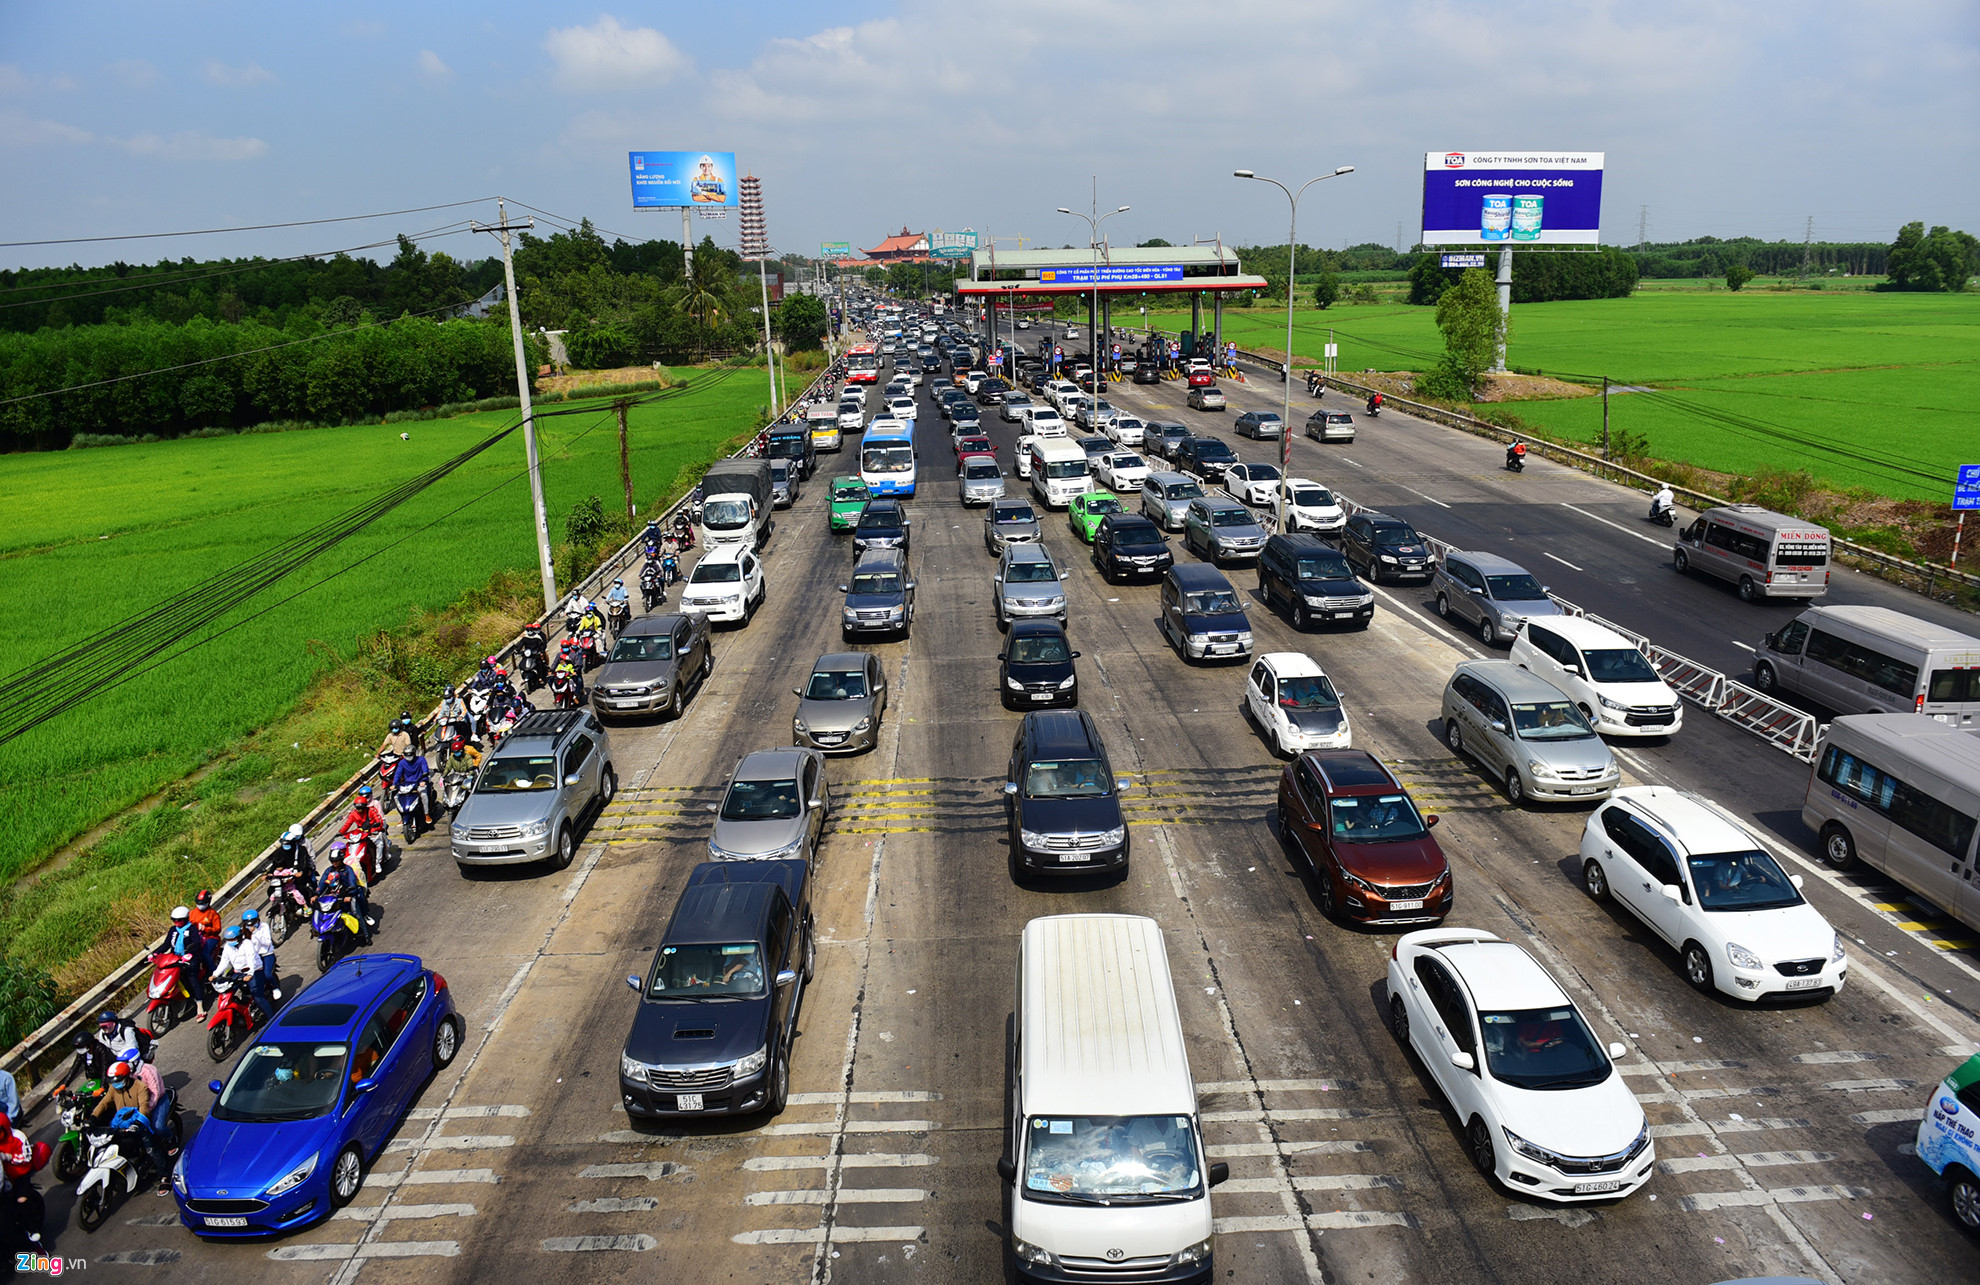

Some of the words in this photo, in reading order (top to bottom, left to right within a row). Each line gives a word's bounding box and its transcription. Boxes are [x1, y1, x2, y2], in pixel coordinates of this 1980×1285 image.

[1445, 156, 1464, 165] TOA
[1473, 155, 1492, 164] CÔNG
[1524, 156, 1539, 164] SƠN
[1554, 155, 1570, 165] VIỆT
[1455, 179, 1470, 187] SƠN
[1471, 178, 1492, 187] CÔNG
[1493, 178, 1514, 189] NGHỆ
[1514, 179, 1530, 187] CHO
[1531, 178, 1552, 189] CUỘC
[1552, 177, 1574, 187] SỐNG
[1489, 200, 1506, 208] TOA
[1520, 200, 1537, 208] TOA
[1781, 531, 1801, 540] MIỀN
[1804, 531, 1826, 540] ĐÔNG
[1957, 1123, 1975, 1139] THAO
[1953, 1132, 1974, 1148] KHÔNG
